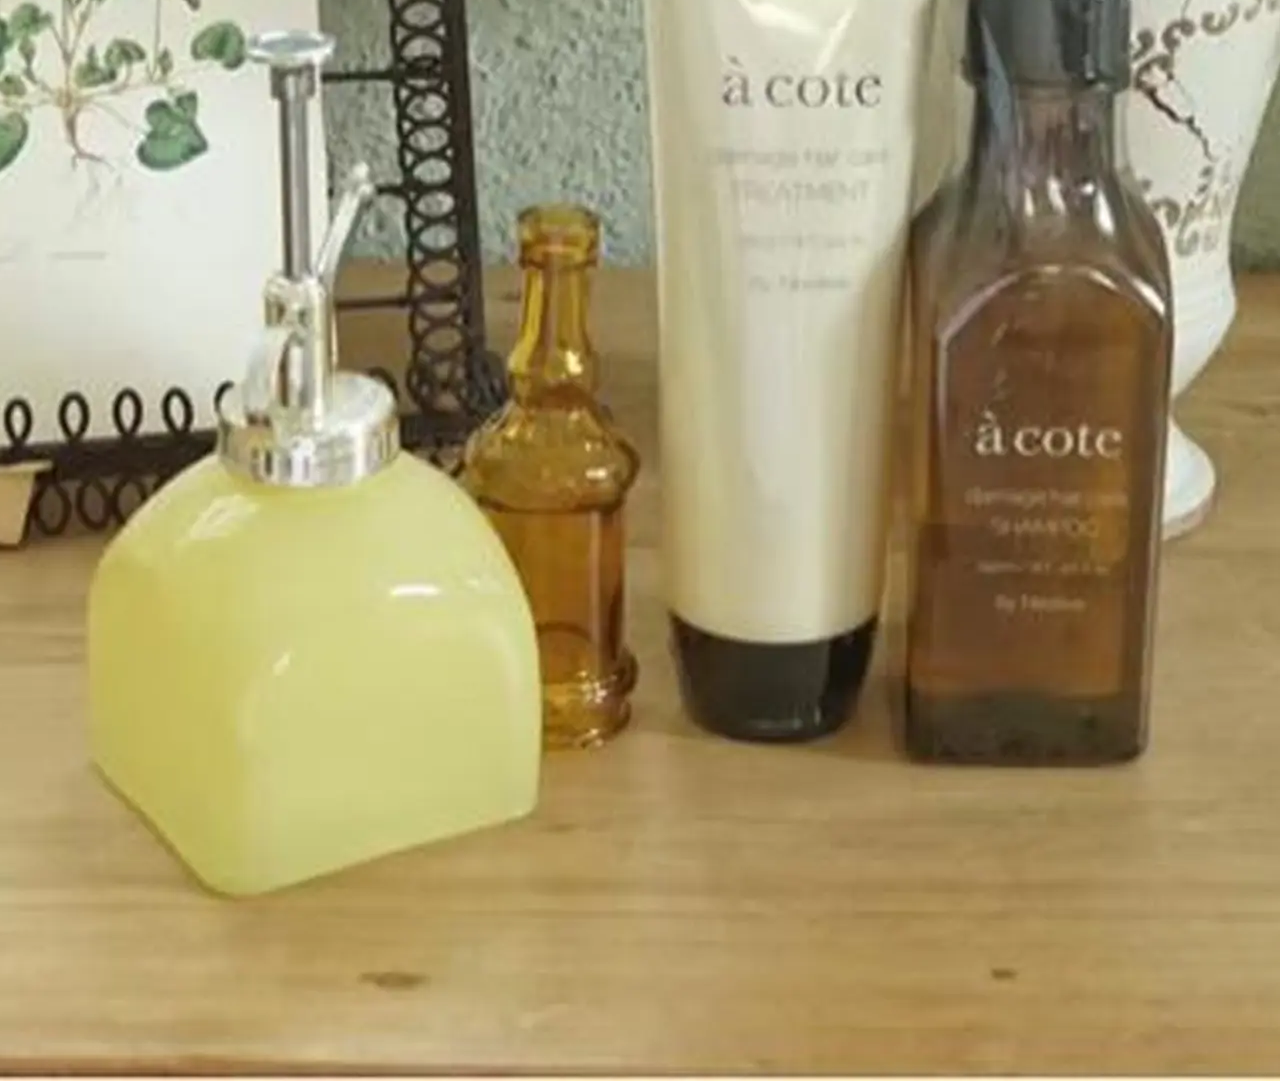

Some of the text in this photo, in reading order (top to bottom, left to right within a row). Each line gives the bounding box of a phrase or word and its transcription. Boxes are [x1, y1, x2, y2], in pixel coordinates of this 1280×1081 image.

[721, 55, 752, 108] à
[974, 408, 1124, 460] à cote
